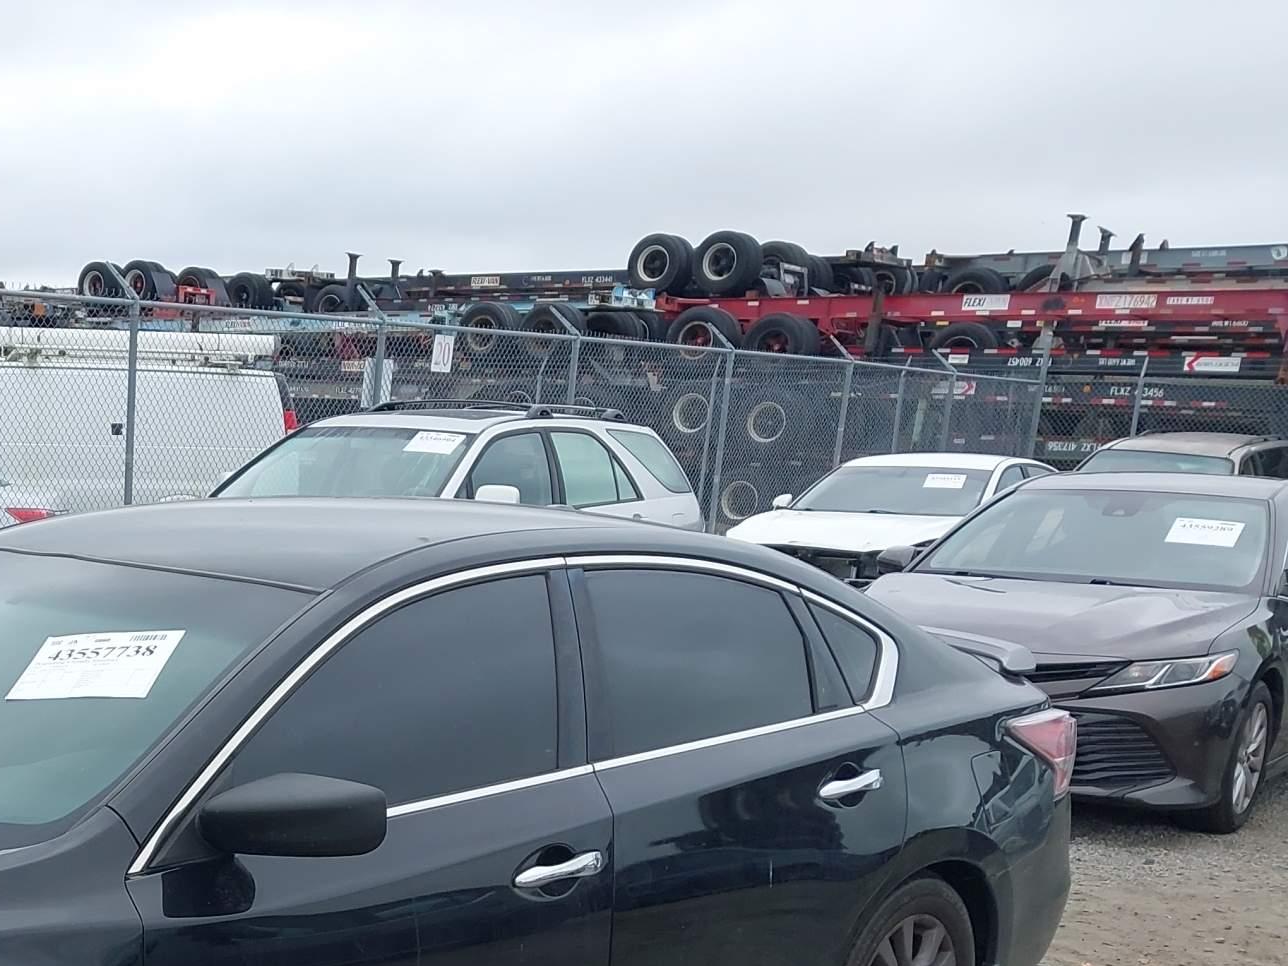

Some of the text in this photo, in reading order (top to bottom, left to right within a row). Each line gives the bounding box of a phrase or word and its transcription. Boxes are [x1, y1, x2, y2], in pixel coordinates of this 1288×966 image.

[433, 342, 452, 367] 20
[1110, 386, 1164, 397] FLXZ 3456
[47, 644, 158, 661] 43557738
